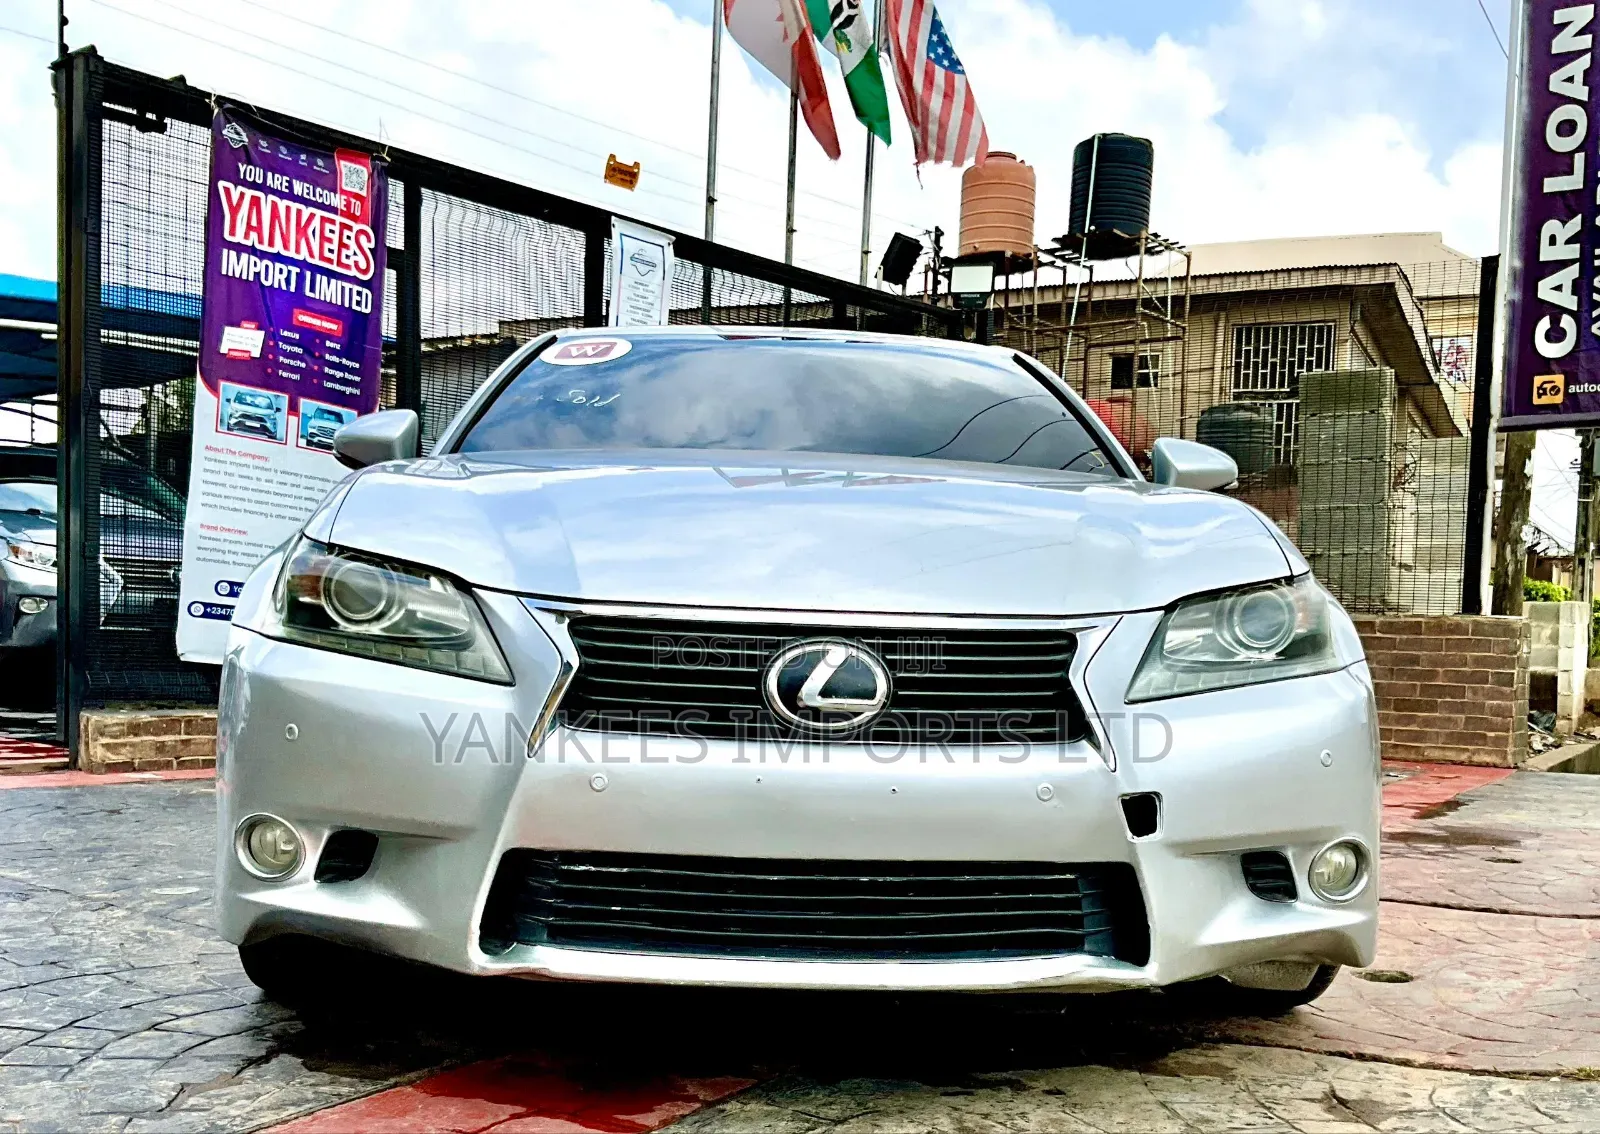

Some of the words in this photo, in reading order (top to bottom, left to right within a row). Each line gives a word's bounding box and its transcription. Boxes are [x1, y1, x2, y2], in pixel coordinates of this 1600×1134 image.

[1543, 4, 1594, 193] LOAN
[238, 162, 264, 184] YOU
[266, 172, 290, 193] ARE
[293, 179, 347, 211] WELCOME
[350, 199, 361, 217] TO
[218, 181, 375, 281] YANKEES
[221, 248, 300, 293] IMPORT
[305, 270, 372, 314] LIMITED
[1535, 214, 1582, 358] CAR
[298, 314, 321, 327] ORDER
[321, 320, 338, 330] NOW
[280, 329, 300, 340] Lexus
[279, 342, 303, 354] Toyota
[325, 340, 341, 350] Benz
[279, 356, 306, 369] Porsche
[325, 354, 360, 369] Rolls-Royce
[279, 370, 300, 381] Ferrari
[324, 366, 344, 379] Range
[344, 371, 361, 382] Rover
[324, 380, 360, 396] Lamborghini
[205, 445, 223, 453] About
[204, 455, 227, 464] Yankees
[253, 464, 271, 472] Limited
[201, 501, 218, 510] which
[200, 523, 218, 531] Brand
